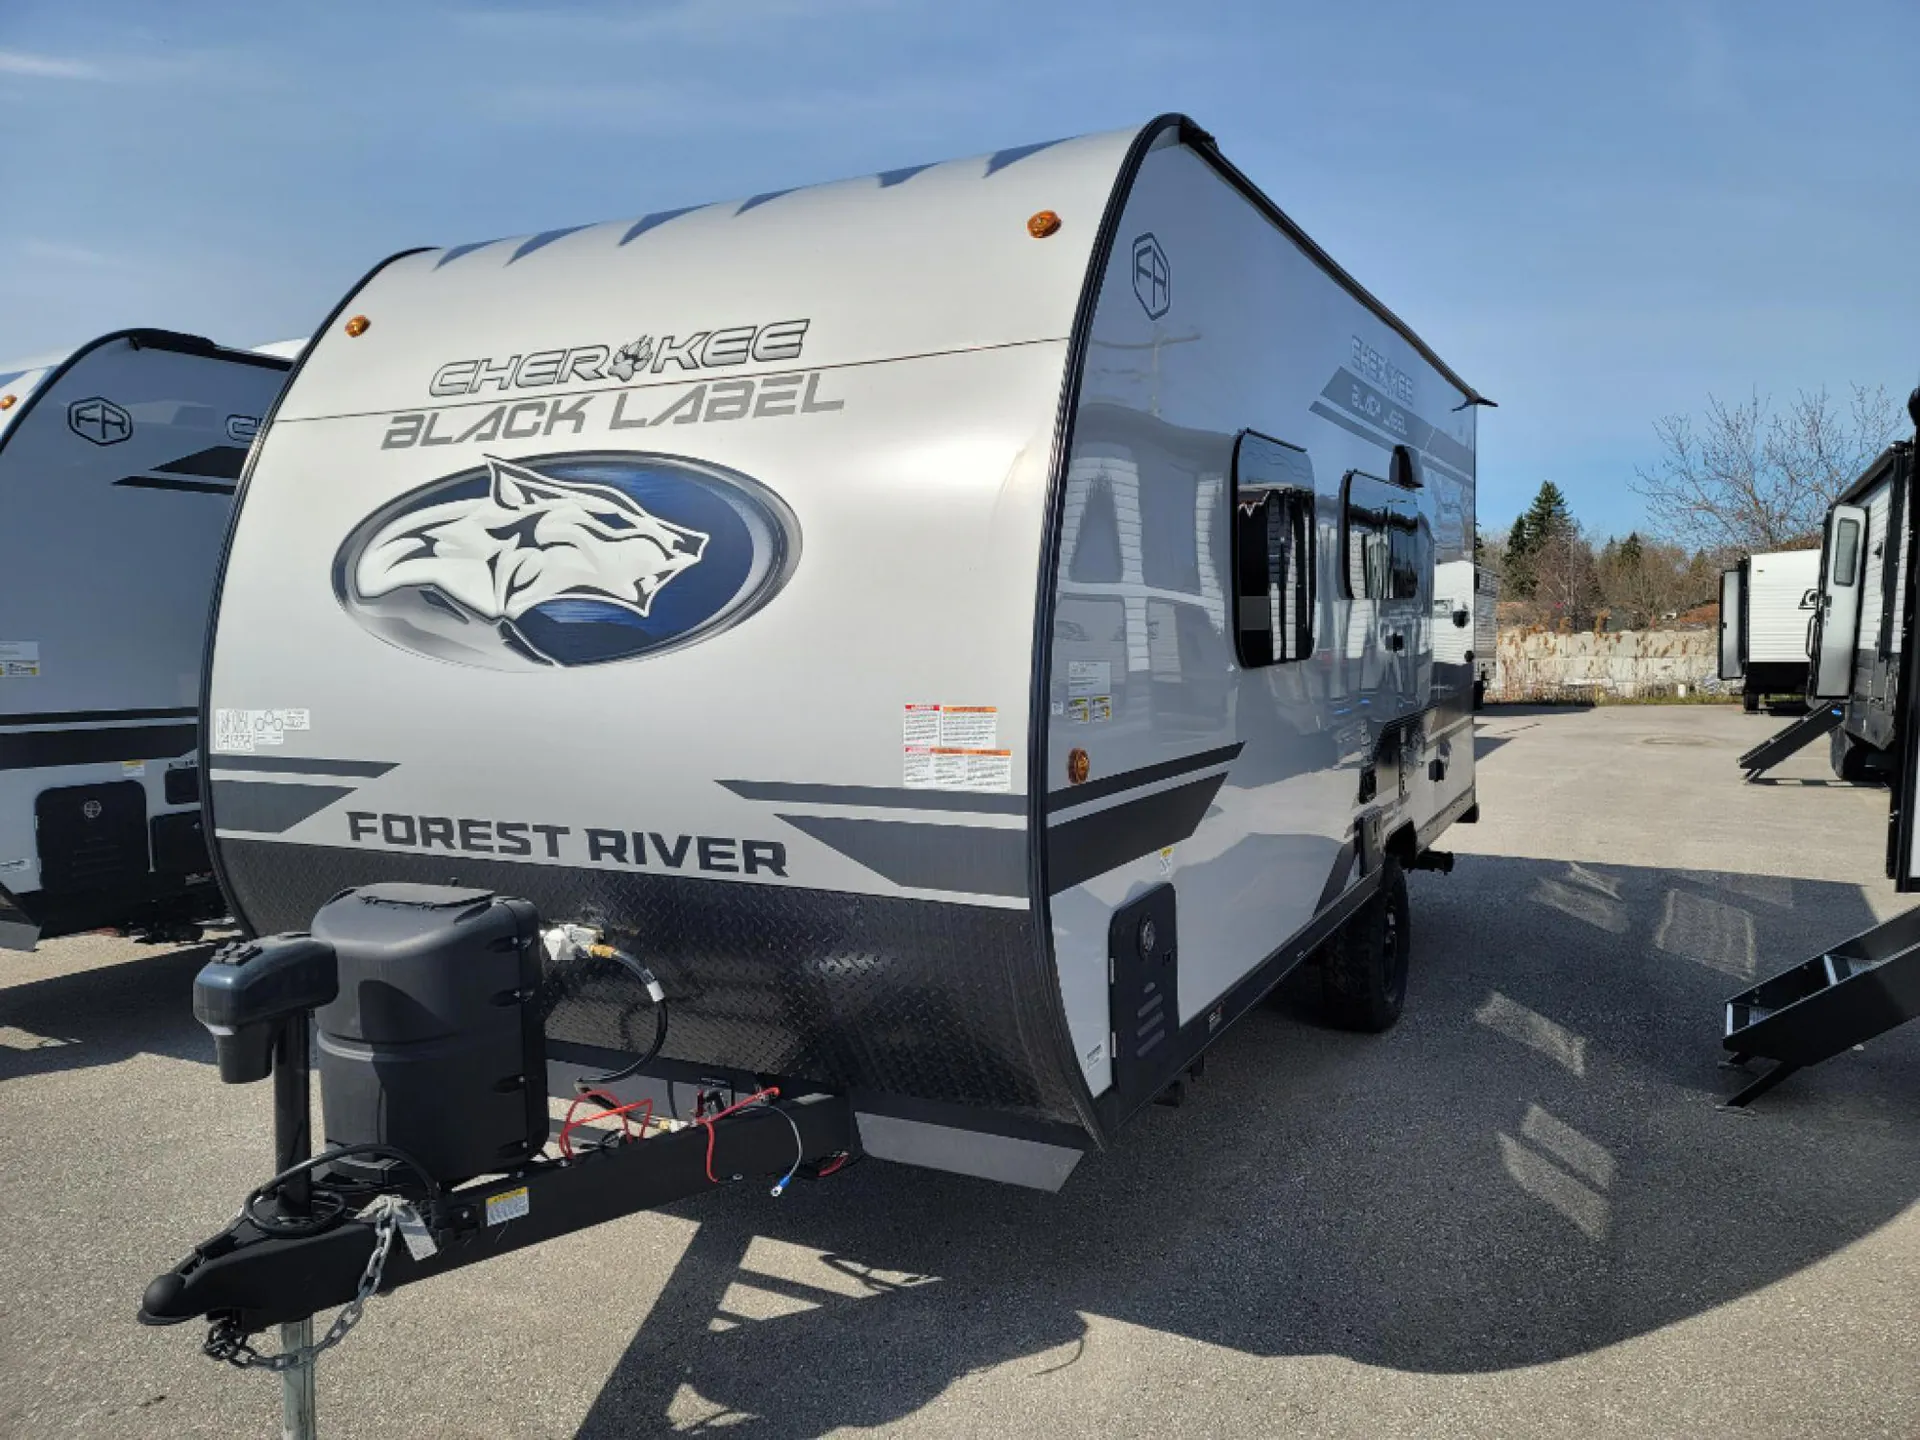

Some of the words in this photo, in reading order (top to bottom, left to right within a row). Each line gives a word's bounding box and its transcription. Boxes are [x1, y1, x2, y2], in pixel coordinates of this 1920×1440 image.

[381, 395, 596, 450] BLACK
[609, 372, 845, 430] LABEL
[346, 811, 571, 858] FOREST
[584, 828, 790, 878] RIVER
